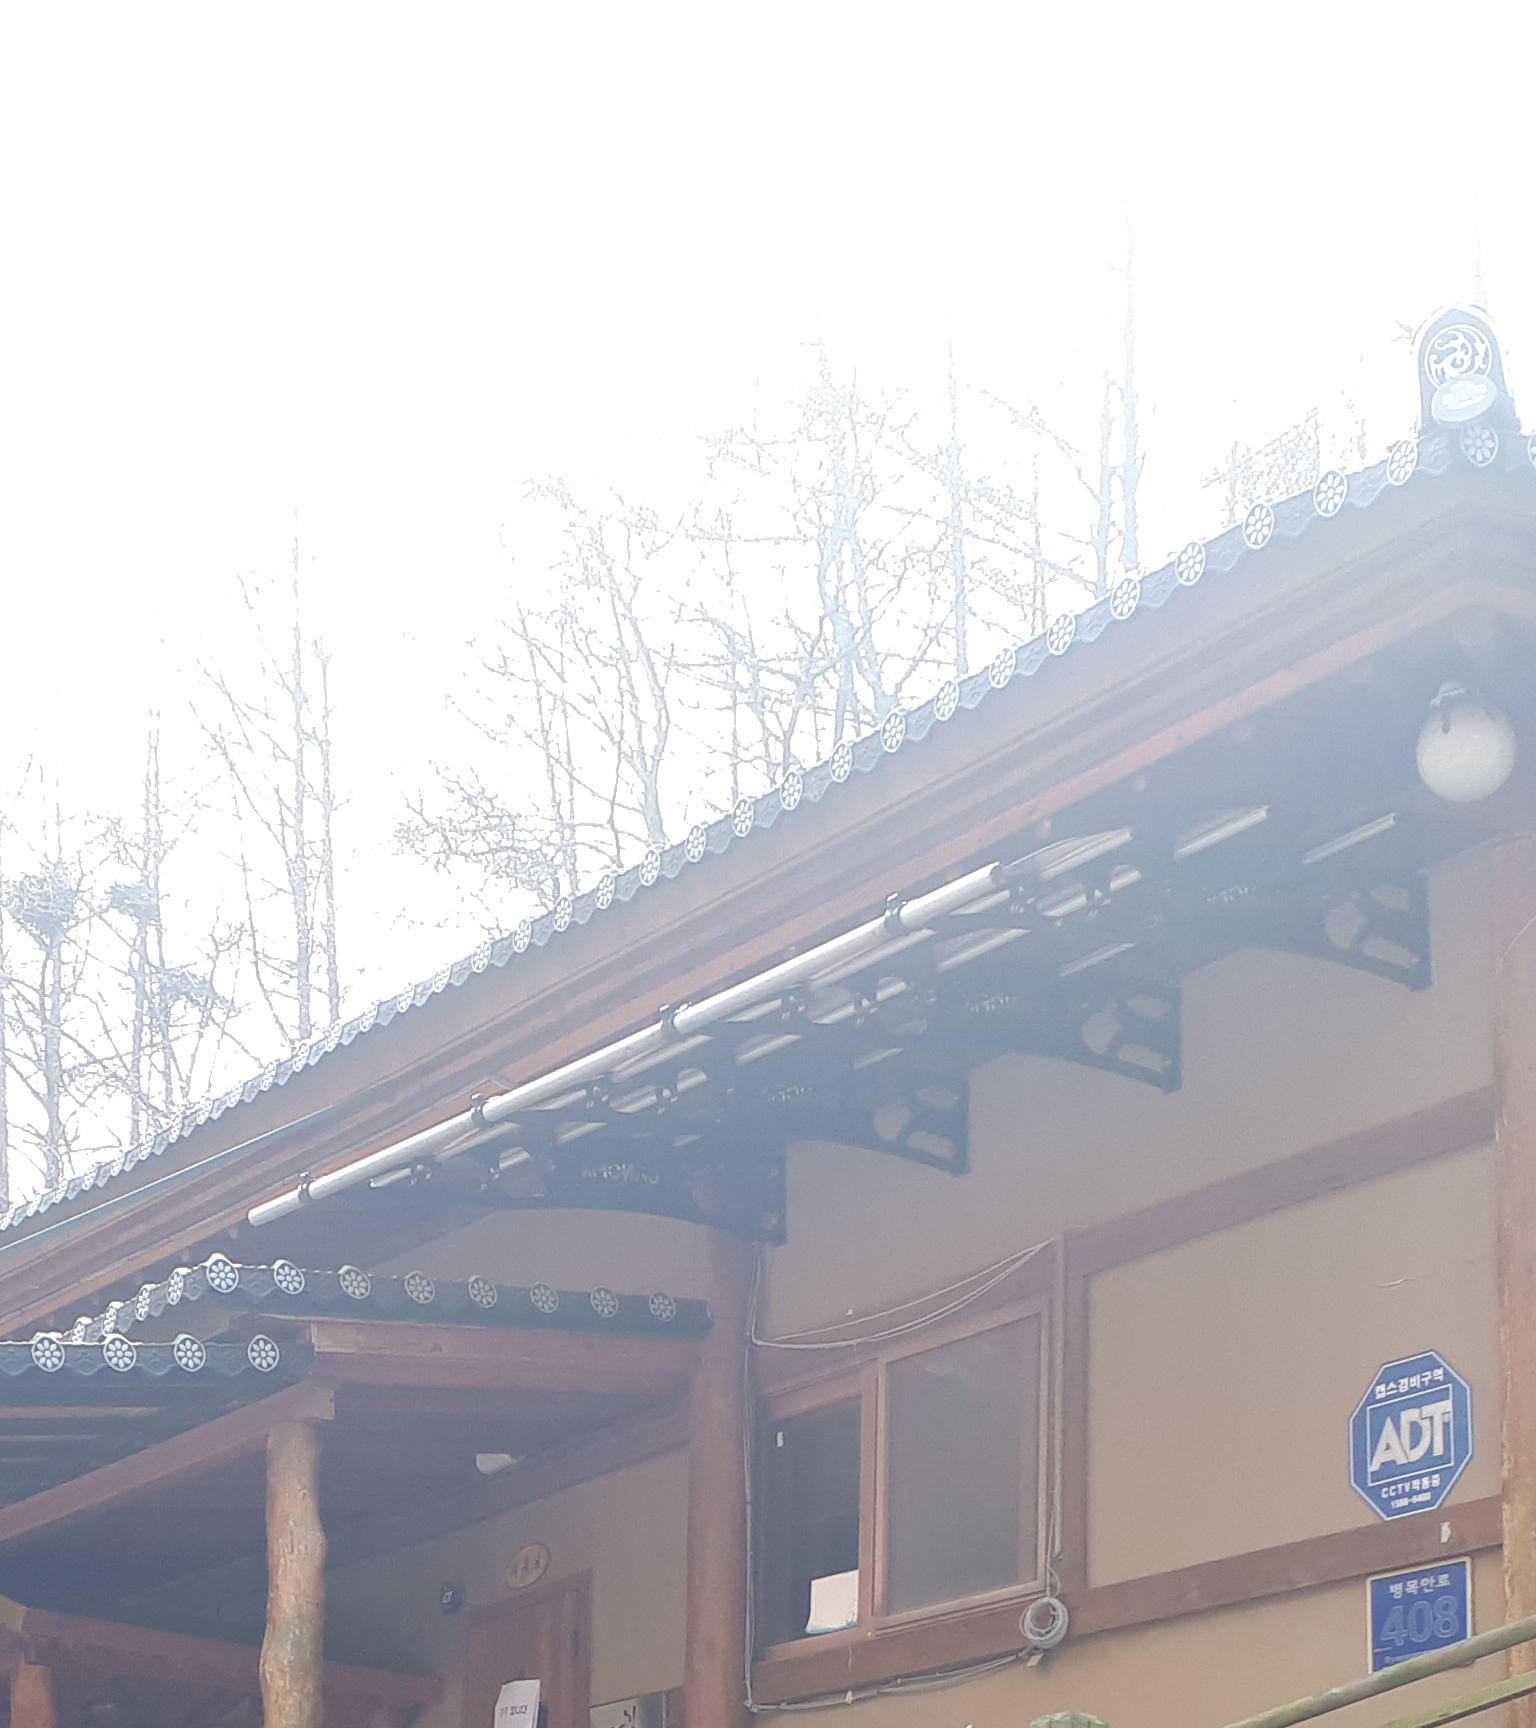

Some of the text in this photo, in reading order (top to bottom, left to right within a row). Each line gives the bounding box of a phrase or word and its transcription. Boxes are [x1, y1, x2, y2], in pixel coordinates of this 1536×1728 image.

[1375, 1367, 1444, 1400] 캡스경비구역
[1370, 1400, 1452, 1472] ADT
[1389, 1573, 1451, 1599] 병목안로
[1381, 1595, 1459, 1646] 408
